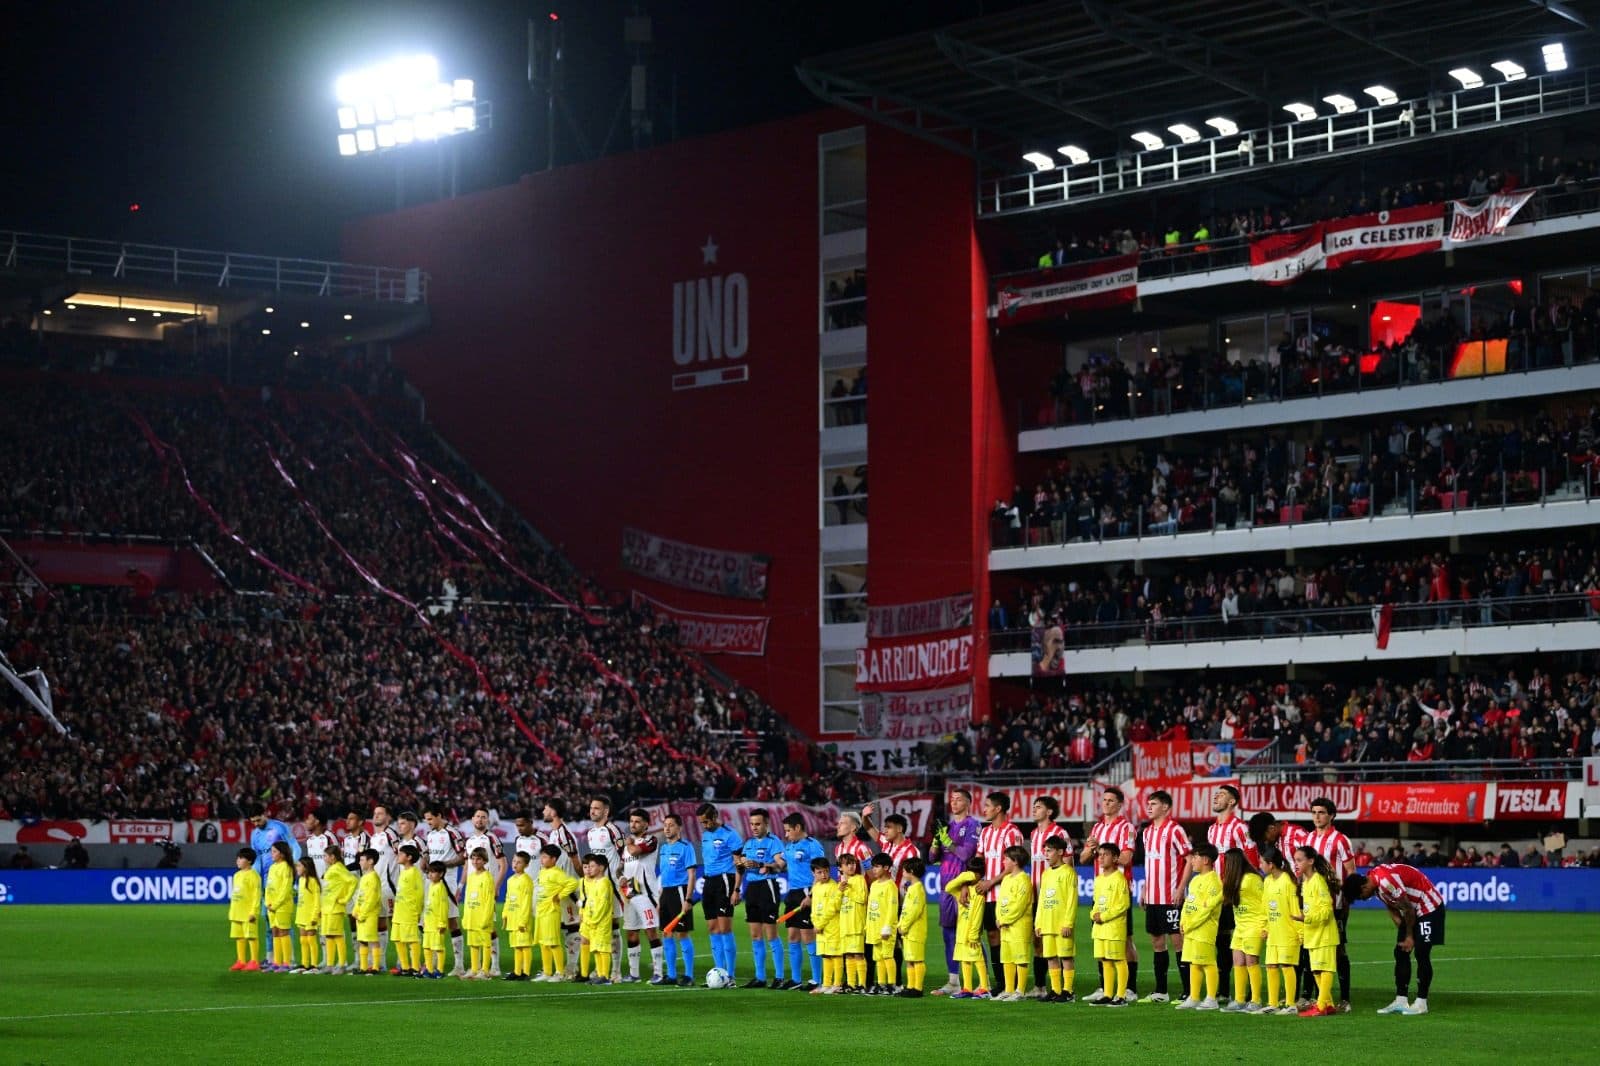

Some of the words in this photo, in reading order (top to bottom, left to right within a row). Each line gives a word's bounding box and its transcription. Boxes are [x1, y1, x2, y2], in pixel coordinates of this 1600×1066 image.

[1361, 225, 1434, 244] CELESTRE
[672, 272, 749, 366] UNO
[948, 783, 1084, 818] BRATGUI
[1241, 786, 1278, 810] VILLA
[1282, 785, 1355, 810] GARIBALDI
[1405, 797, 1460, 815] Diciembre
[643, 910, 654, 922] 10
[1166, 909, 1180, 923] 32
[1418, 921, 1432, 936] 15
